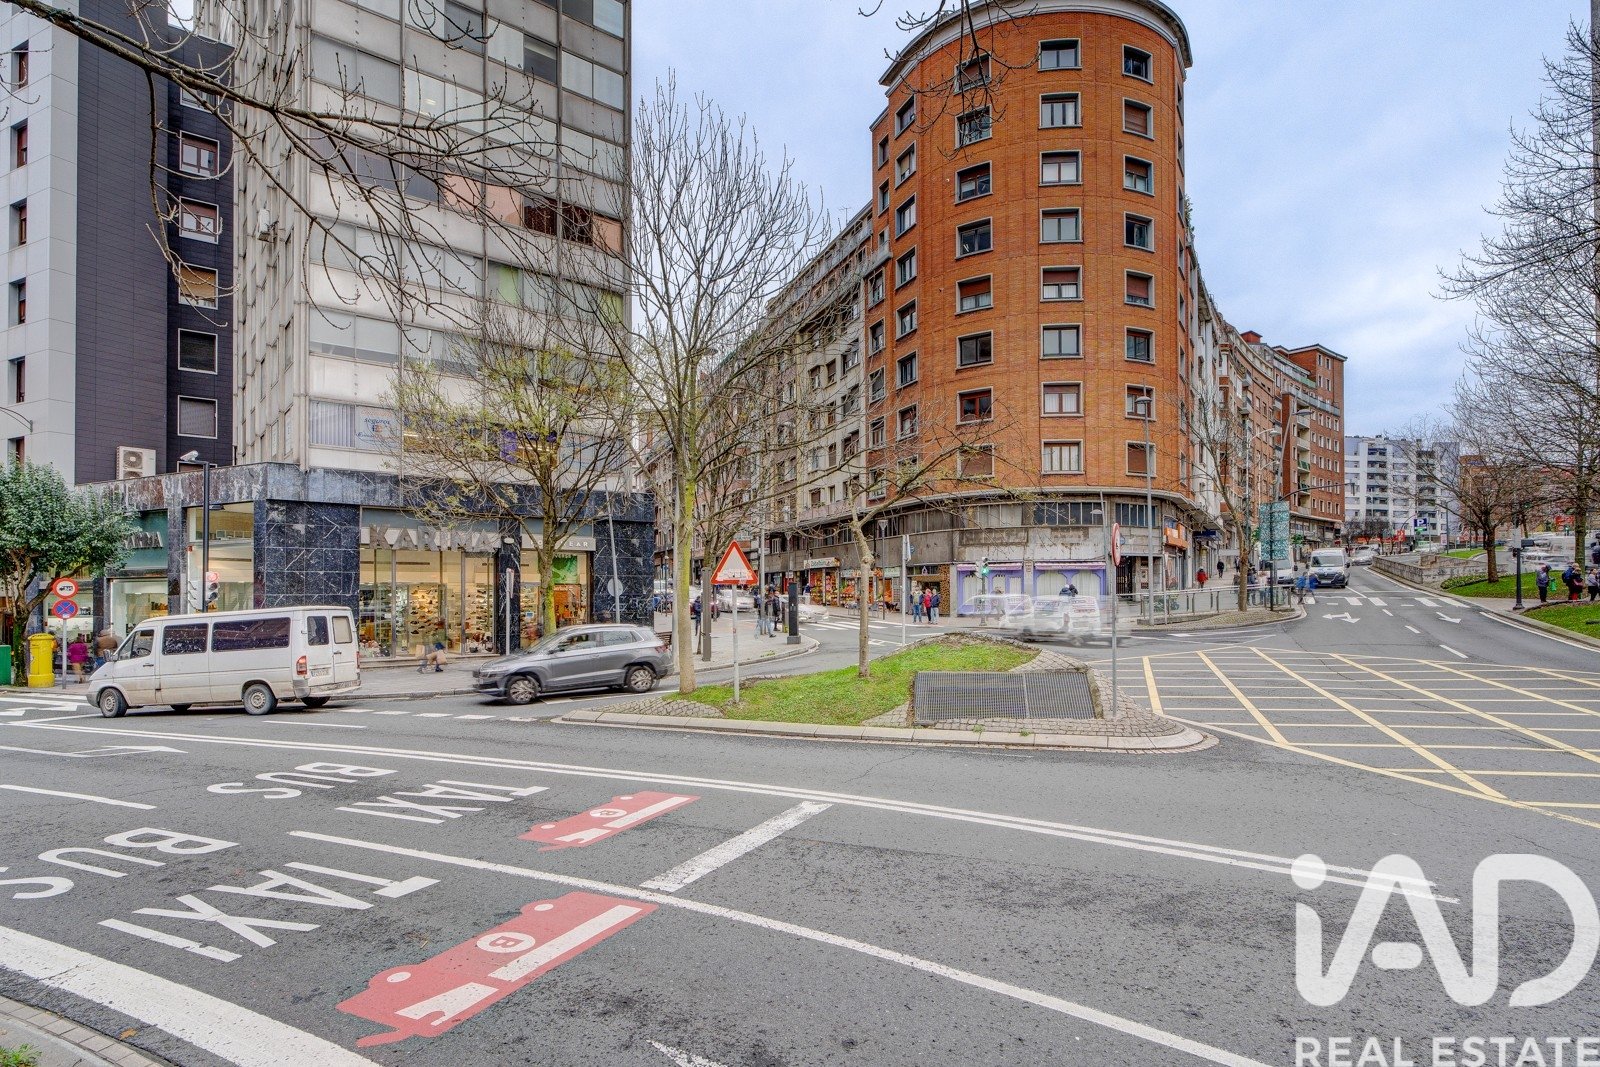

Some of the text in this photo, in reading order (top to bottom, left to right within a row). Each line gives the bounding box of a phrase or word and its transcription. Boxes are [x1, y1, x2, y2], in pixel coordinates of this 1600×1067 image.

[206, 762, 398, 799] BUS
[335, 780, 550, 824] TAXI
[0, 827, 240, 899] BUS
[97, 862, 441, 962] TAXI
[489, 936, 524, 949] B
